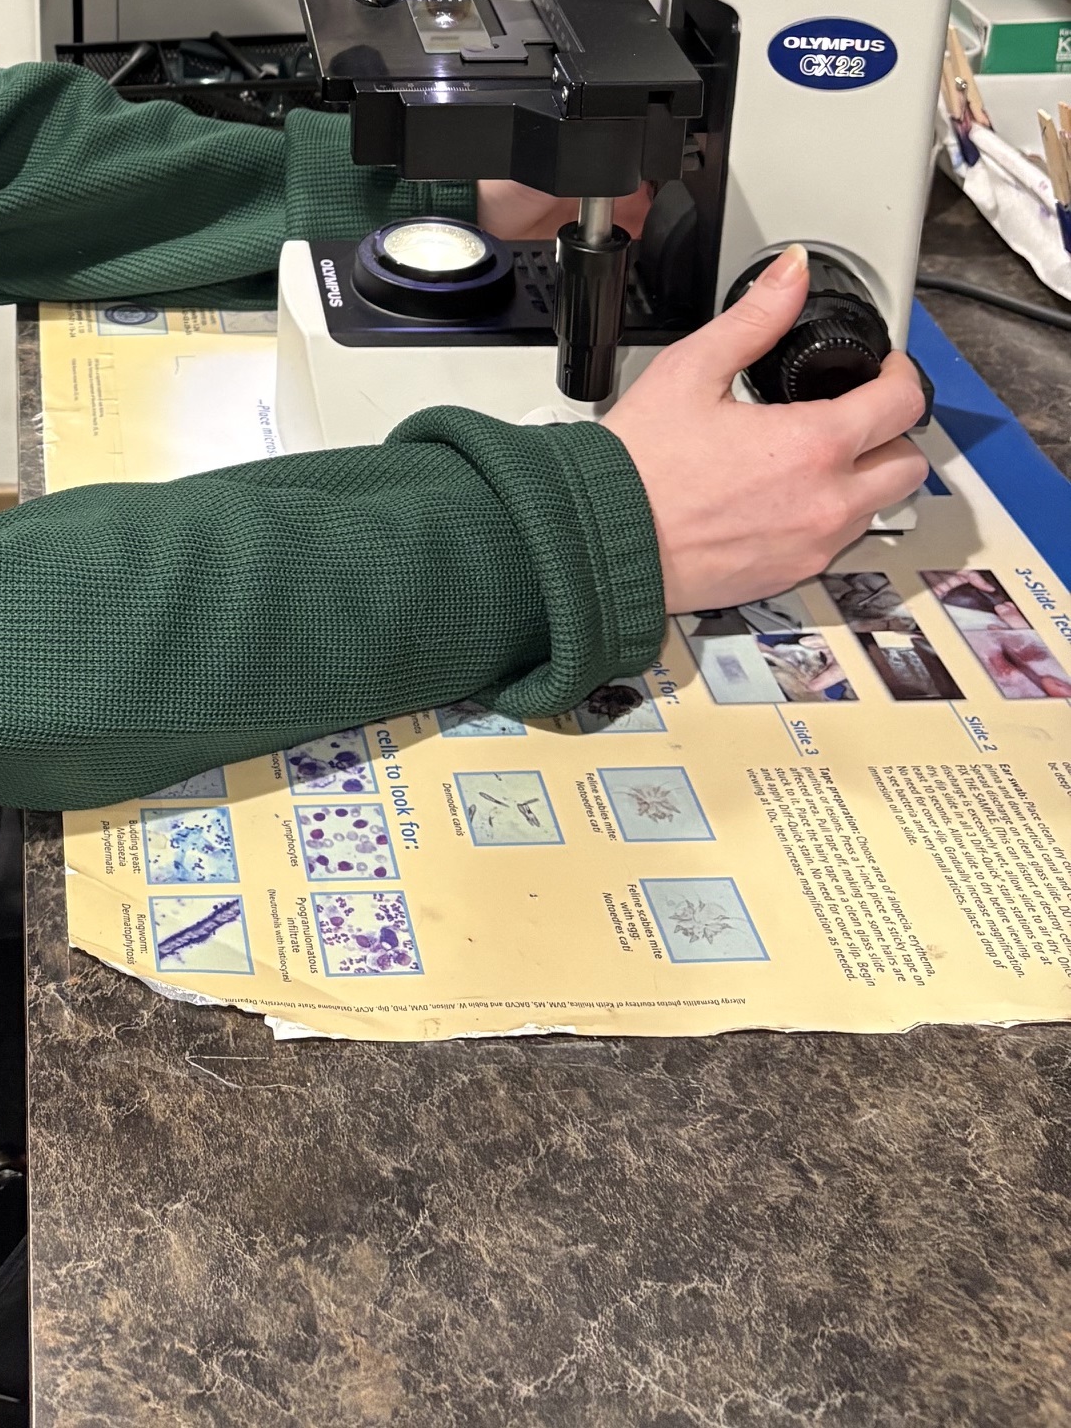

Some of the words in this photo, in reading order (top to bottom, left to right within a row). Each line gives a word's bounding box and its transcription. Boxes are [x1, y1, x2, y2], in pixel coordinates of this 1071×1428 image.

[783, 36, 886, 52] OLYMPUS
[799, 54, 866, 77] CX22
[320, 258, 343, 308] OLYMPUS
[1015, 568, 1056, 610] 3-Slide
[658, 680, 680, 704] for:
[377, 730, 398, 759] cells
[790, 720, 812, 745] Slide
[965, 716, 989, 741] Slide
[385, 765, 402, 779] to
[774, 767, 791, 786] stuck
[390, 785, 415, 816] look
[442, 782, 457, 816] Demodex
[452, 816, 464, 837] canis
[575, 780, 595, 817] Notoedres
[589, 818, 601, 833] cati
[585, 772, 599, 793] Feline
[593, 793, 609, 820] scabies
[604, 820, 617, 841] mite:
[789, 797, 800, 805] it.
[794, 807, 811, 826] Place
[100, 820, 116, 875] pachydermatis
[116, 827, 126, 867] Malassezia
[129, 819, 139, 851] Budding
[282, 820, 299, 867] Lymphocytes
[400, 821, 420, 849] for:
[805, 829, 818, 841] the
[954, 764, 970, 775] FIX
[963, 777, 979, 791] THE
[972, 792, 999, 824] SAMPLE.
[991, 826, 1010, 844] (This
[1005, 846, 1019, 859] can
[1015, 862, 1038, 887] distort
[1039, 900, 1063, 931] destroy
[130, 851, 141, 874] yeast:
[801, 766, 824, 794] pruritus
[824, 805, 843, 832] lesions.
[839, 835, 856, 854] Press
[855, 864, 874, 889] 1-inch
[866, 892, 886, 913] piece
[887, 926, 907, 951] sticky
[901, 953, 917, 972] tape
[813, 843, 829, 863] hairy
[789, 767, 812, 796] affected
[805, 798, 819, 816] area.
[815, 818, 830, 832] Pull
[823, 834, 838, 851] tape
[833, 853, 848, 866] off,
[841, 869, 863, 897] making
[857, 900, 872, 917] sure
[867, 920, 885, 941] some
[880, 944, 898, 965] hairs
[892, 967, 905, 981] are
[818, 767, 833, 784] Tape
[826, 786, 860, 834] preparation:
[855, 835, 876, 863] Choose
[871, 865, 886, 882] area
[887, 896, 911, 932] alopecia,
[908, 934, 935, 976] erythema,
[823, 865, 839, 882] tape
[903, 777, 921, 794] need
[913, 796, 926, 806] for
[921, 808, 939, 827] cover
[933, 829, 947, 844] slip.
[943, 846, 971, 882] Gradually
[965, 884, 990, 916] increase
[985, 919, 1024, 978] magnification.
[602, 892, 624, 934] Notoedres
[618, 935, 633, 952] cati
[620, 901, 633, 922] with
[627, 922, 641, 941] egg:
[627, 883, 642, 908] Feline
[637, 908, 654, 938] scabies
[649, 938, 663, 960] mite
[844, 904, 861, 926] clean
[122, 903, 136, 965] Dermatophytosis
[136, 913, 148, 954] Ringworm:
[286, 917, 300, 954] infiltrate
[296, 897, 318, 974] Pyogranulomatous
[854, 929, 873, 950] glass
[868, 952, 884, 972] slide
